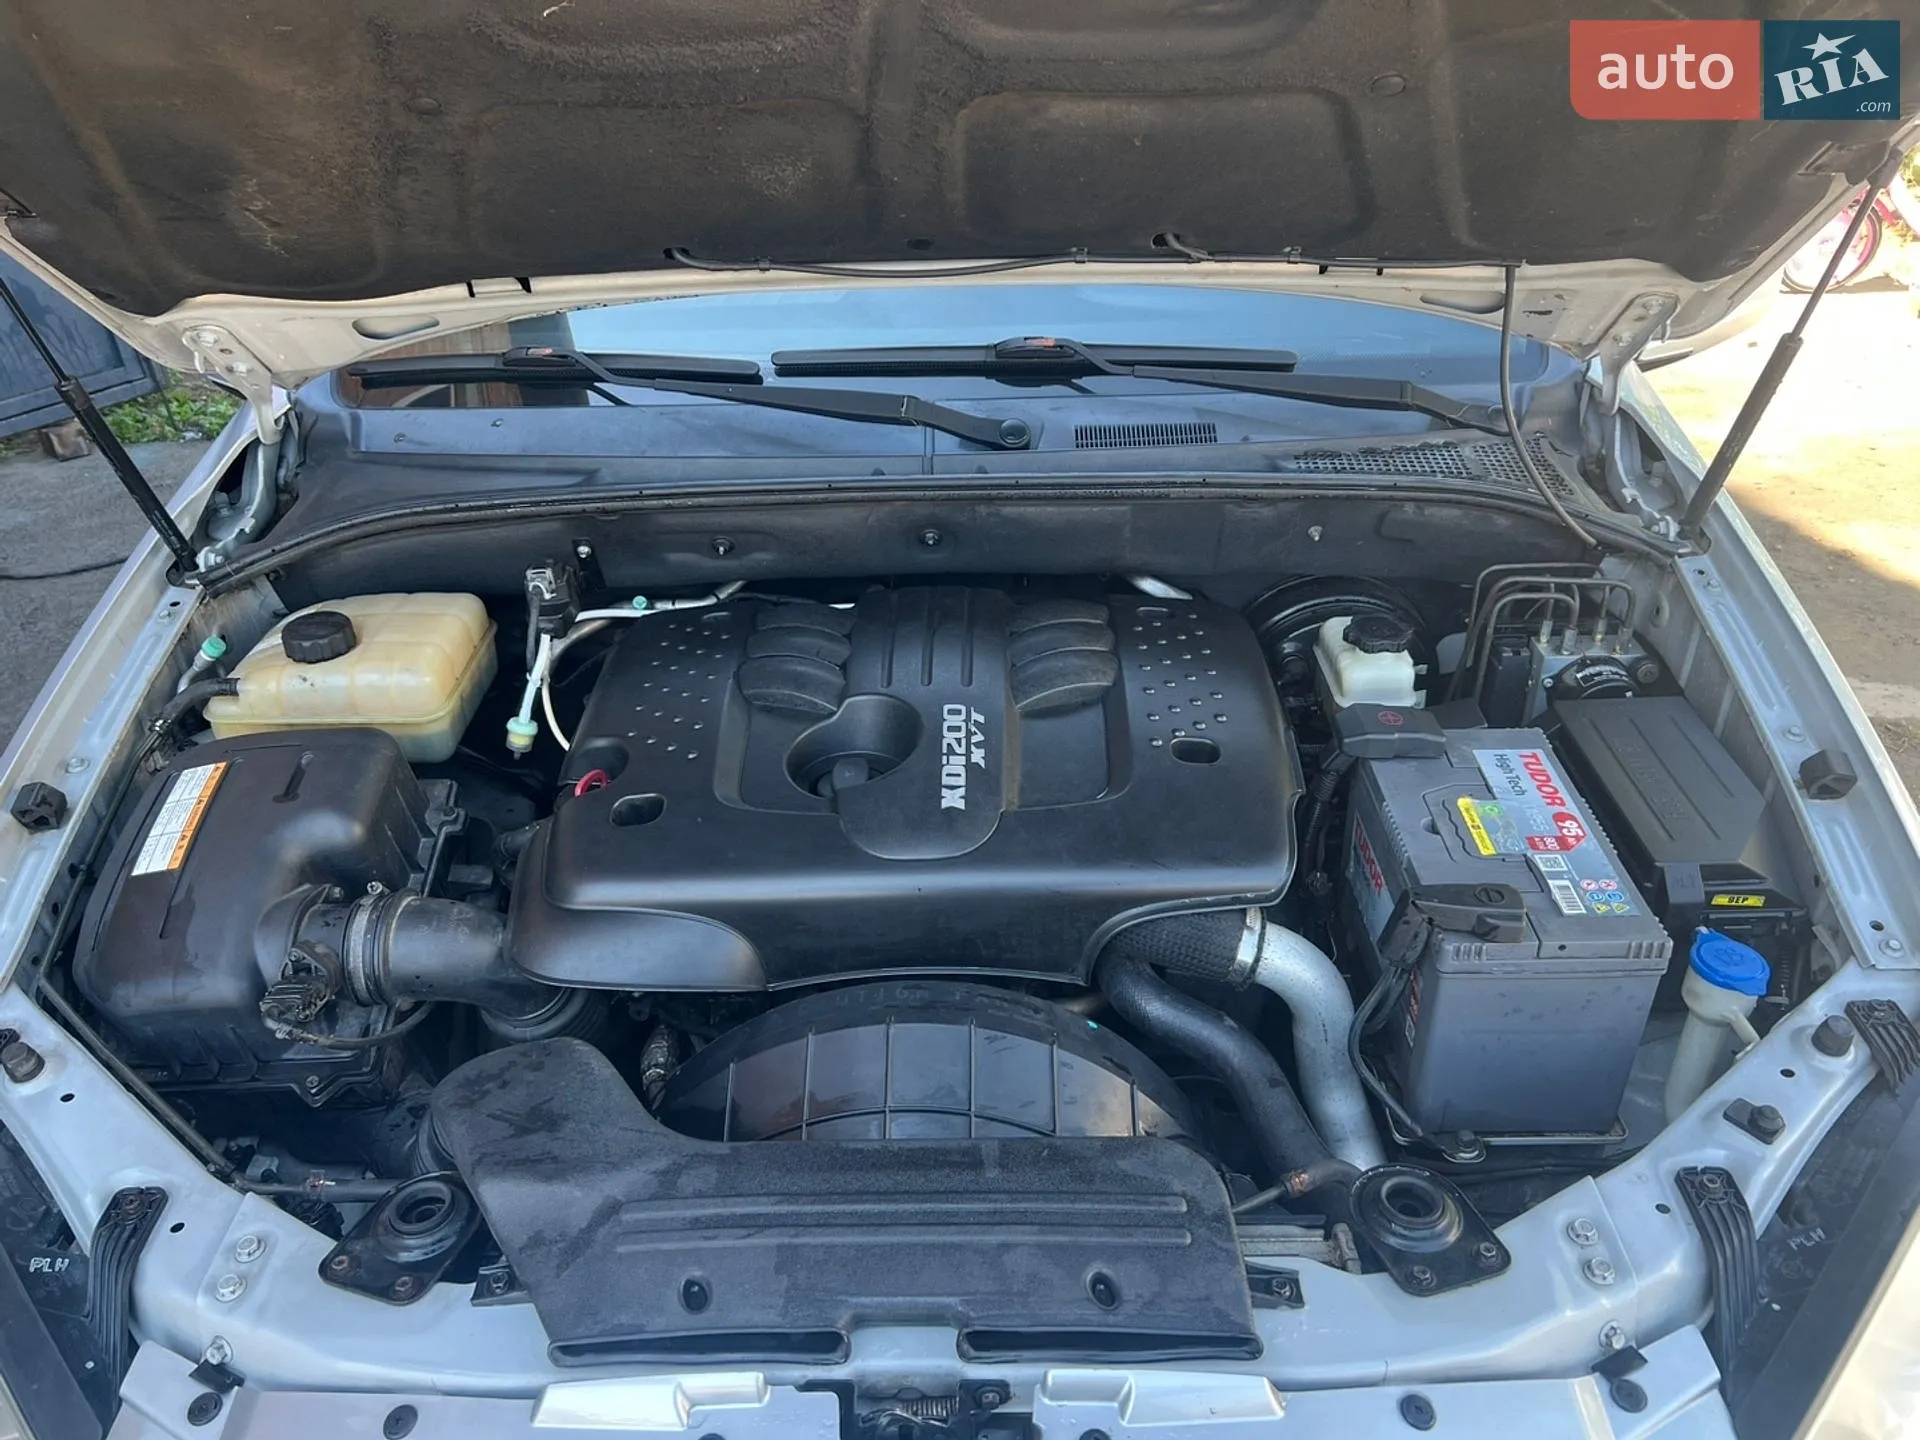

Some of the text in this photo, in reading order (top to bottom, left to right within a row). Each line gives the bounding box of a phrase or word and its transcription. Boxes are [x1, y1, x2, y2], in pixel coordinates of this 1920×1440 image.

[941, 703, 966, 810] XDi200
[1493, 752, 1527, 797] High Tech
[1518, 752, 1567, 808] TUDOR
[1556, 819, 1584, 837] 95
